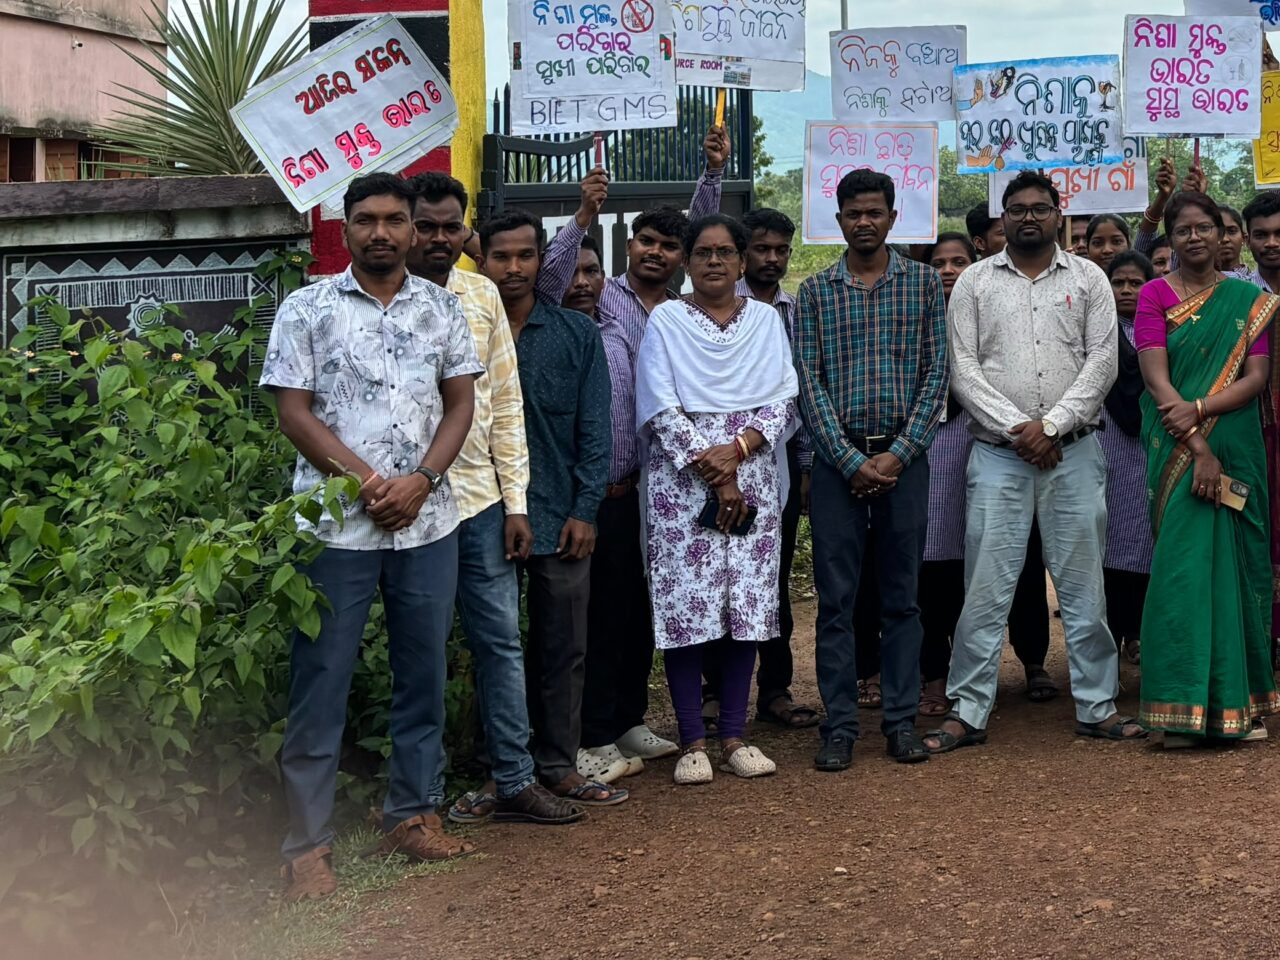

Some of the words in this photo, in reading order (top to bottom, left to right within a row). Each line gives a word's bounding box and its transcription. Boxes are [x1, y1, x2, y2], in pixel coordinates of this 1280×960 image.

[1134, 17, 1177, 48] ନିଶା
[700, 59, 723, 71] ROOM
[1150, 57, 1214, 87] ଭାରତ
[531, 99, 586, 125] BIET
[598, 95, 667, 122] GMS
[1191, 88, 1250, 114] ଭାରତ
[281, 147, 329, 189] ନିଶା
